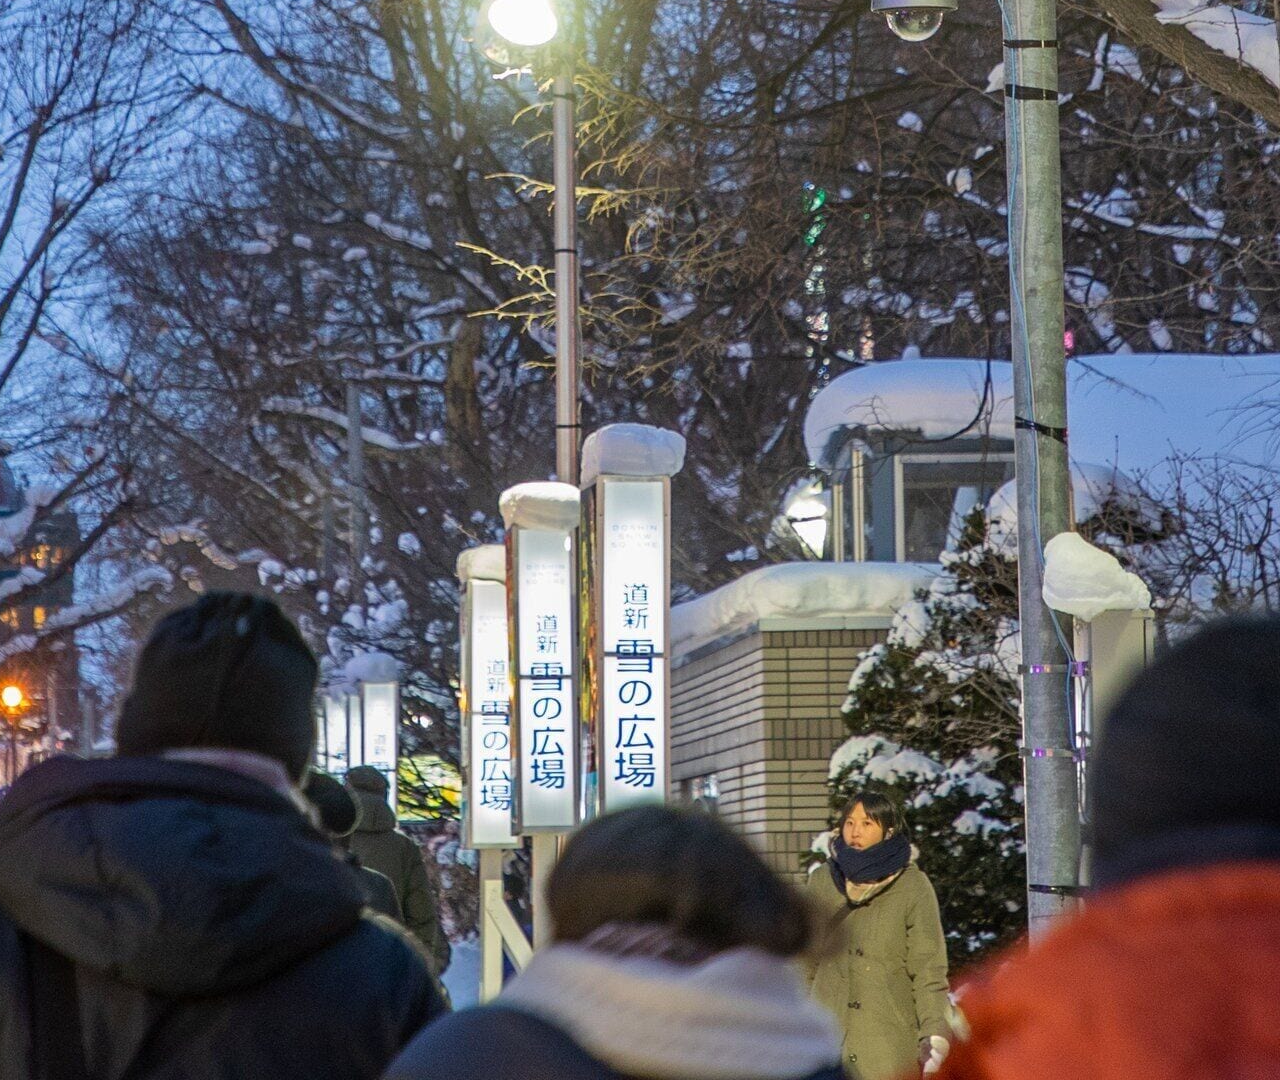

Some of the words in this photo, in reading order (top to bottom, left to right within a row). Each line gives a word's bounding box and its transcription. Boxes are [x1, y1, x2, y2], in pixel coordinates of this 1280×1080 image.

[536, 614, 558, 654] 道新
[623, 583, 649, 629] 道新
[480, 700, 512, 811] 雪の広場
[530, 662, 566, 789] 雪の広場
[614, 639, 656, 788] 雪の広場
